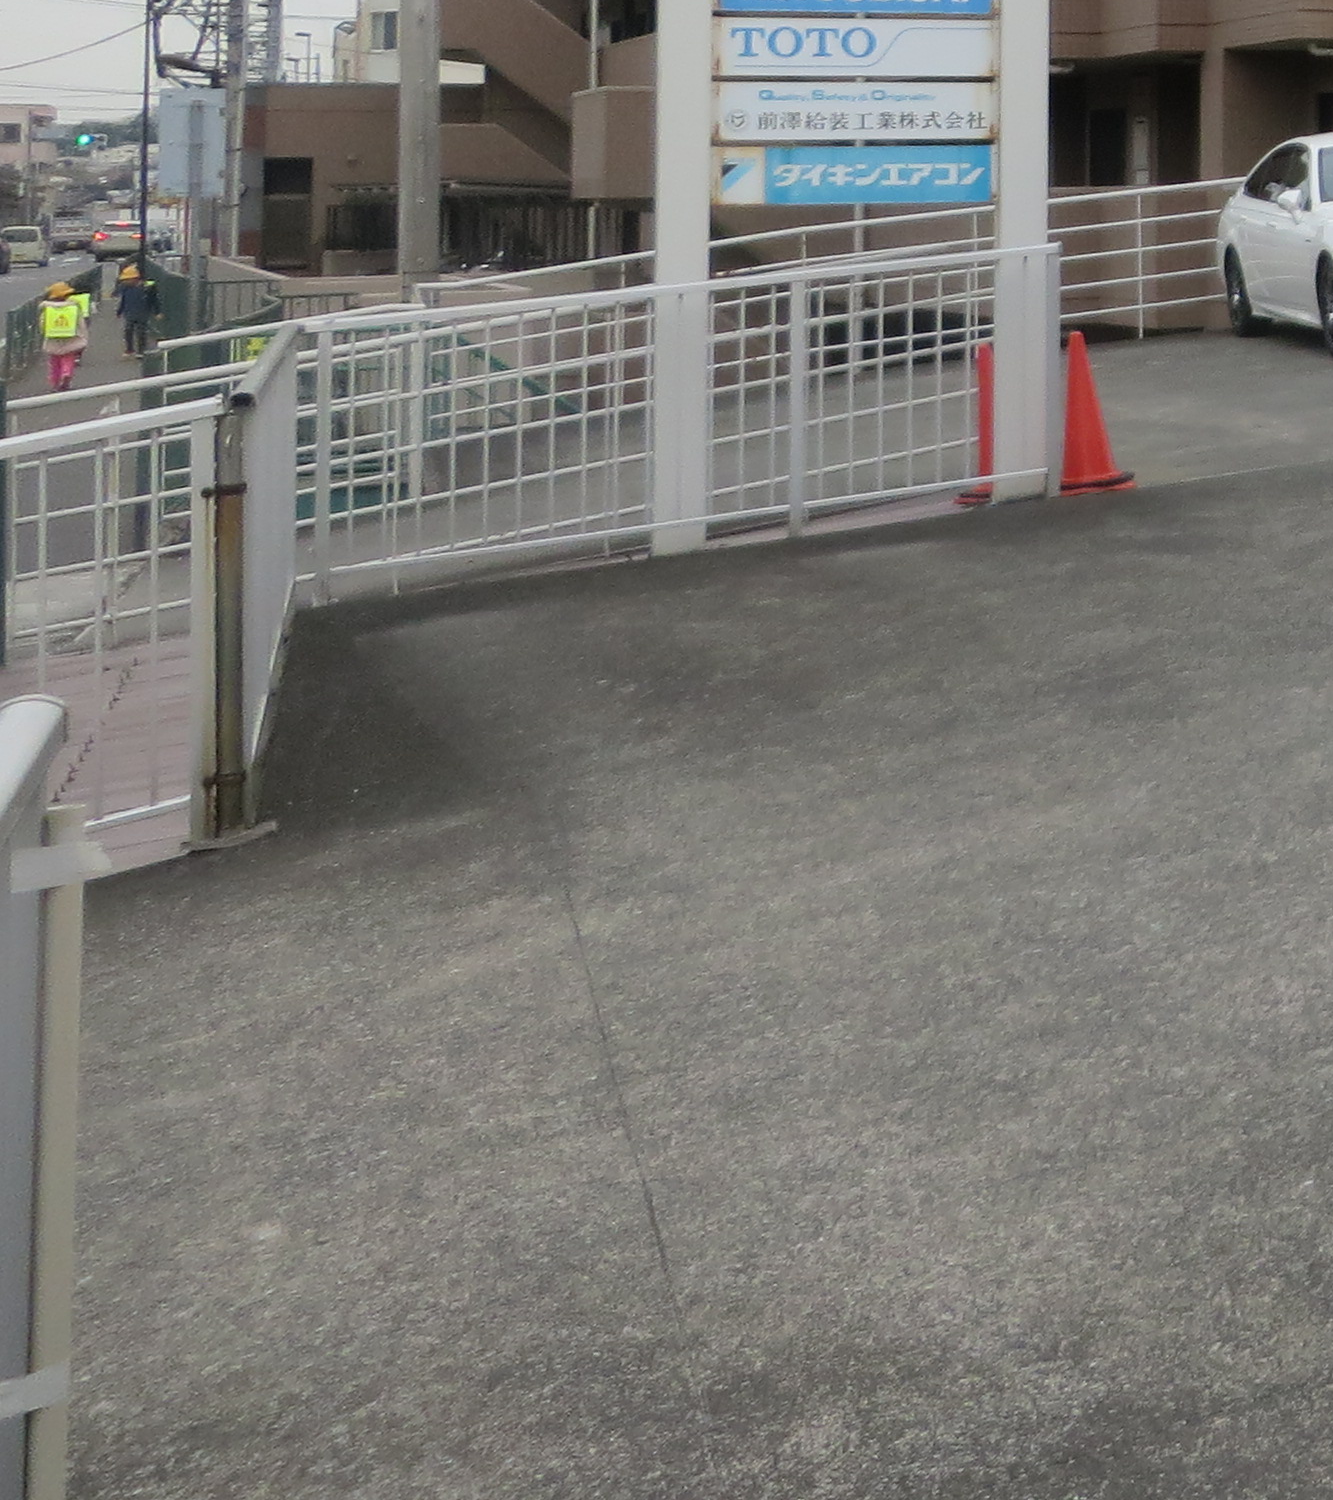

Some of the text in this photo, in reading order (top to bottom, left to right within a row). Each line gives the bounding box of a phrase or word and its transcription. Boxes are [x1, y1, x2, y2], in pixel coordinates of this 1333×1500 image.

[730, 26, 878, 58] TOTO
[757, 110, 988, 131] 前澤給装工業株式会社
